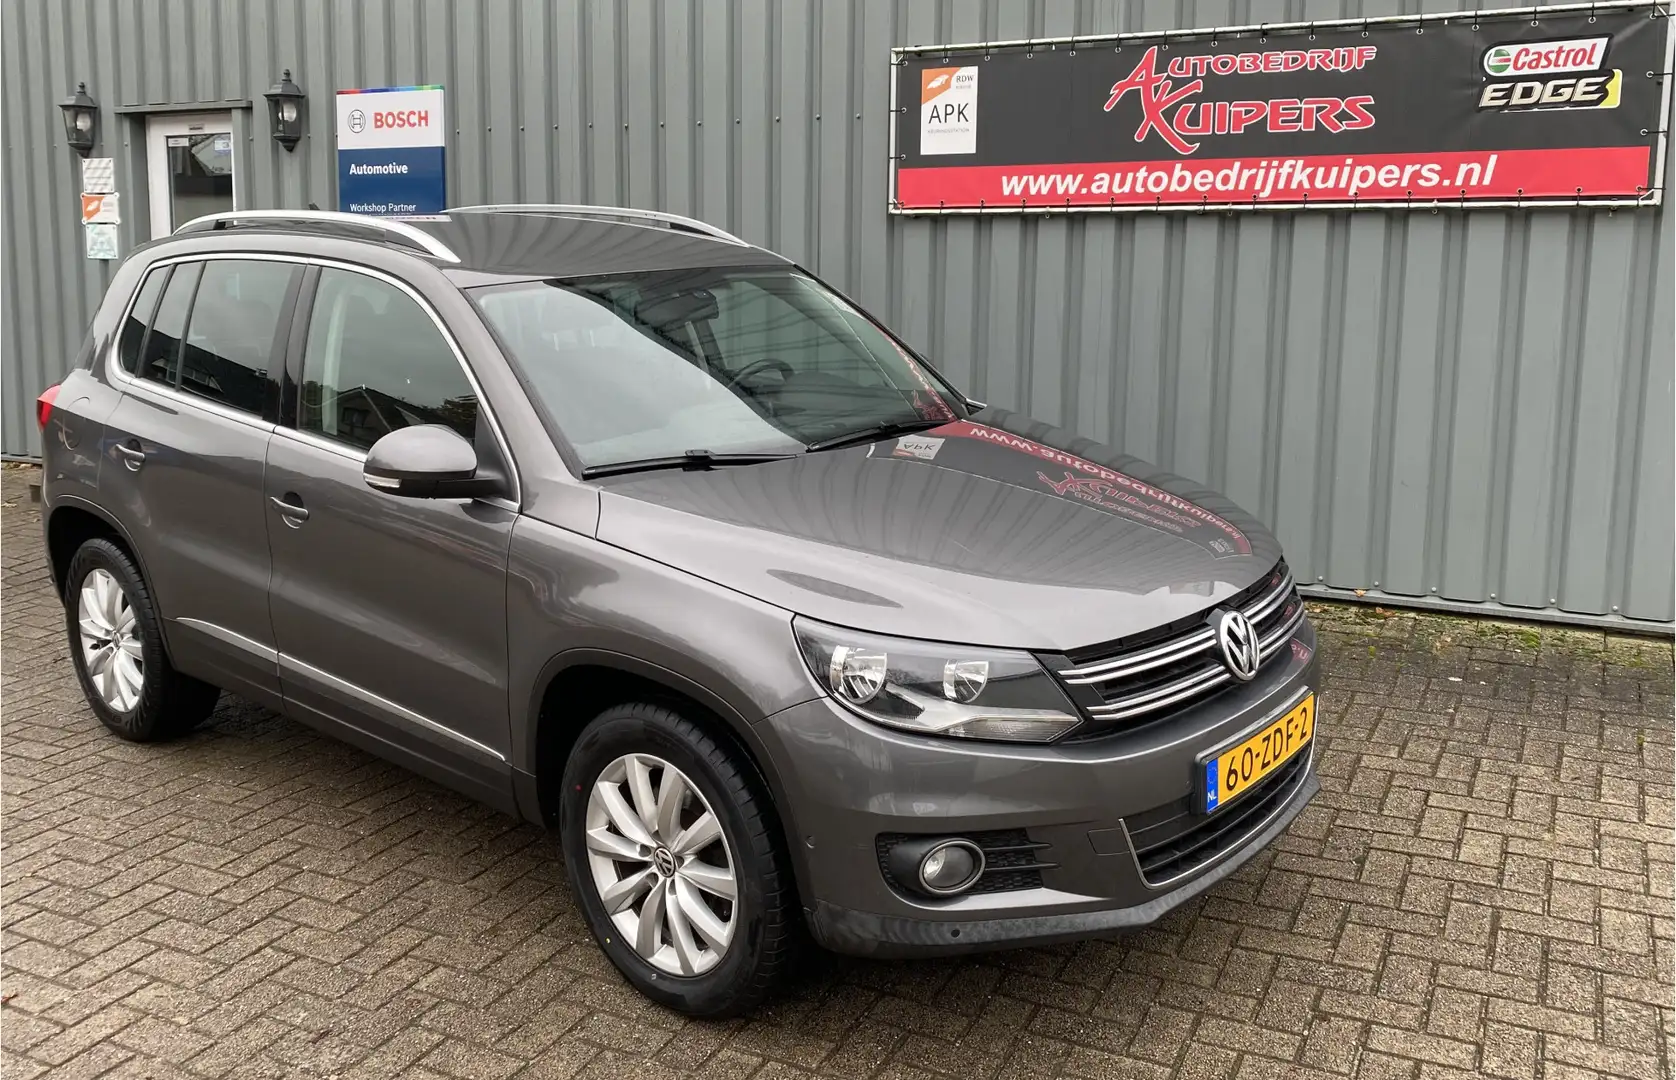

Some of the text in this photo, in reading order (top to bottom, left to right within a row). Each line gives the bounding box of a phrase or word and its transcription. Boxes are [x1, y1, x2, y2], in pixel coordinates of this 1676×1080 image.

[1512, 43, 1598, 71] Castrol
[955, 75, 974, 83] RDW
[1479, 76, 1610, 107] EDGE
[373, 110, 429, 129] BOSCH
[928, 103, 969, 124] APK
[349, 162, 409, 175] Automotive
[1001, 155, 1499, 198] www.autobedrijfkuipers.nl
[349, 203, 417, 213] Workshop Partner
[1207, 791, 1217, 803] NL
